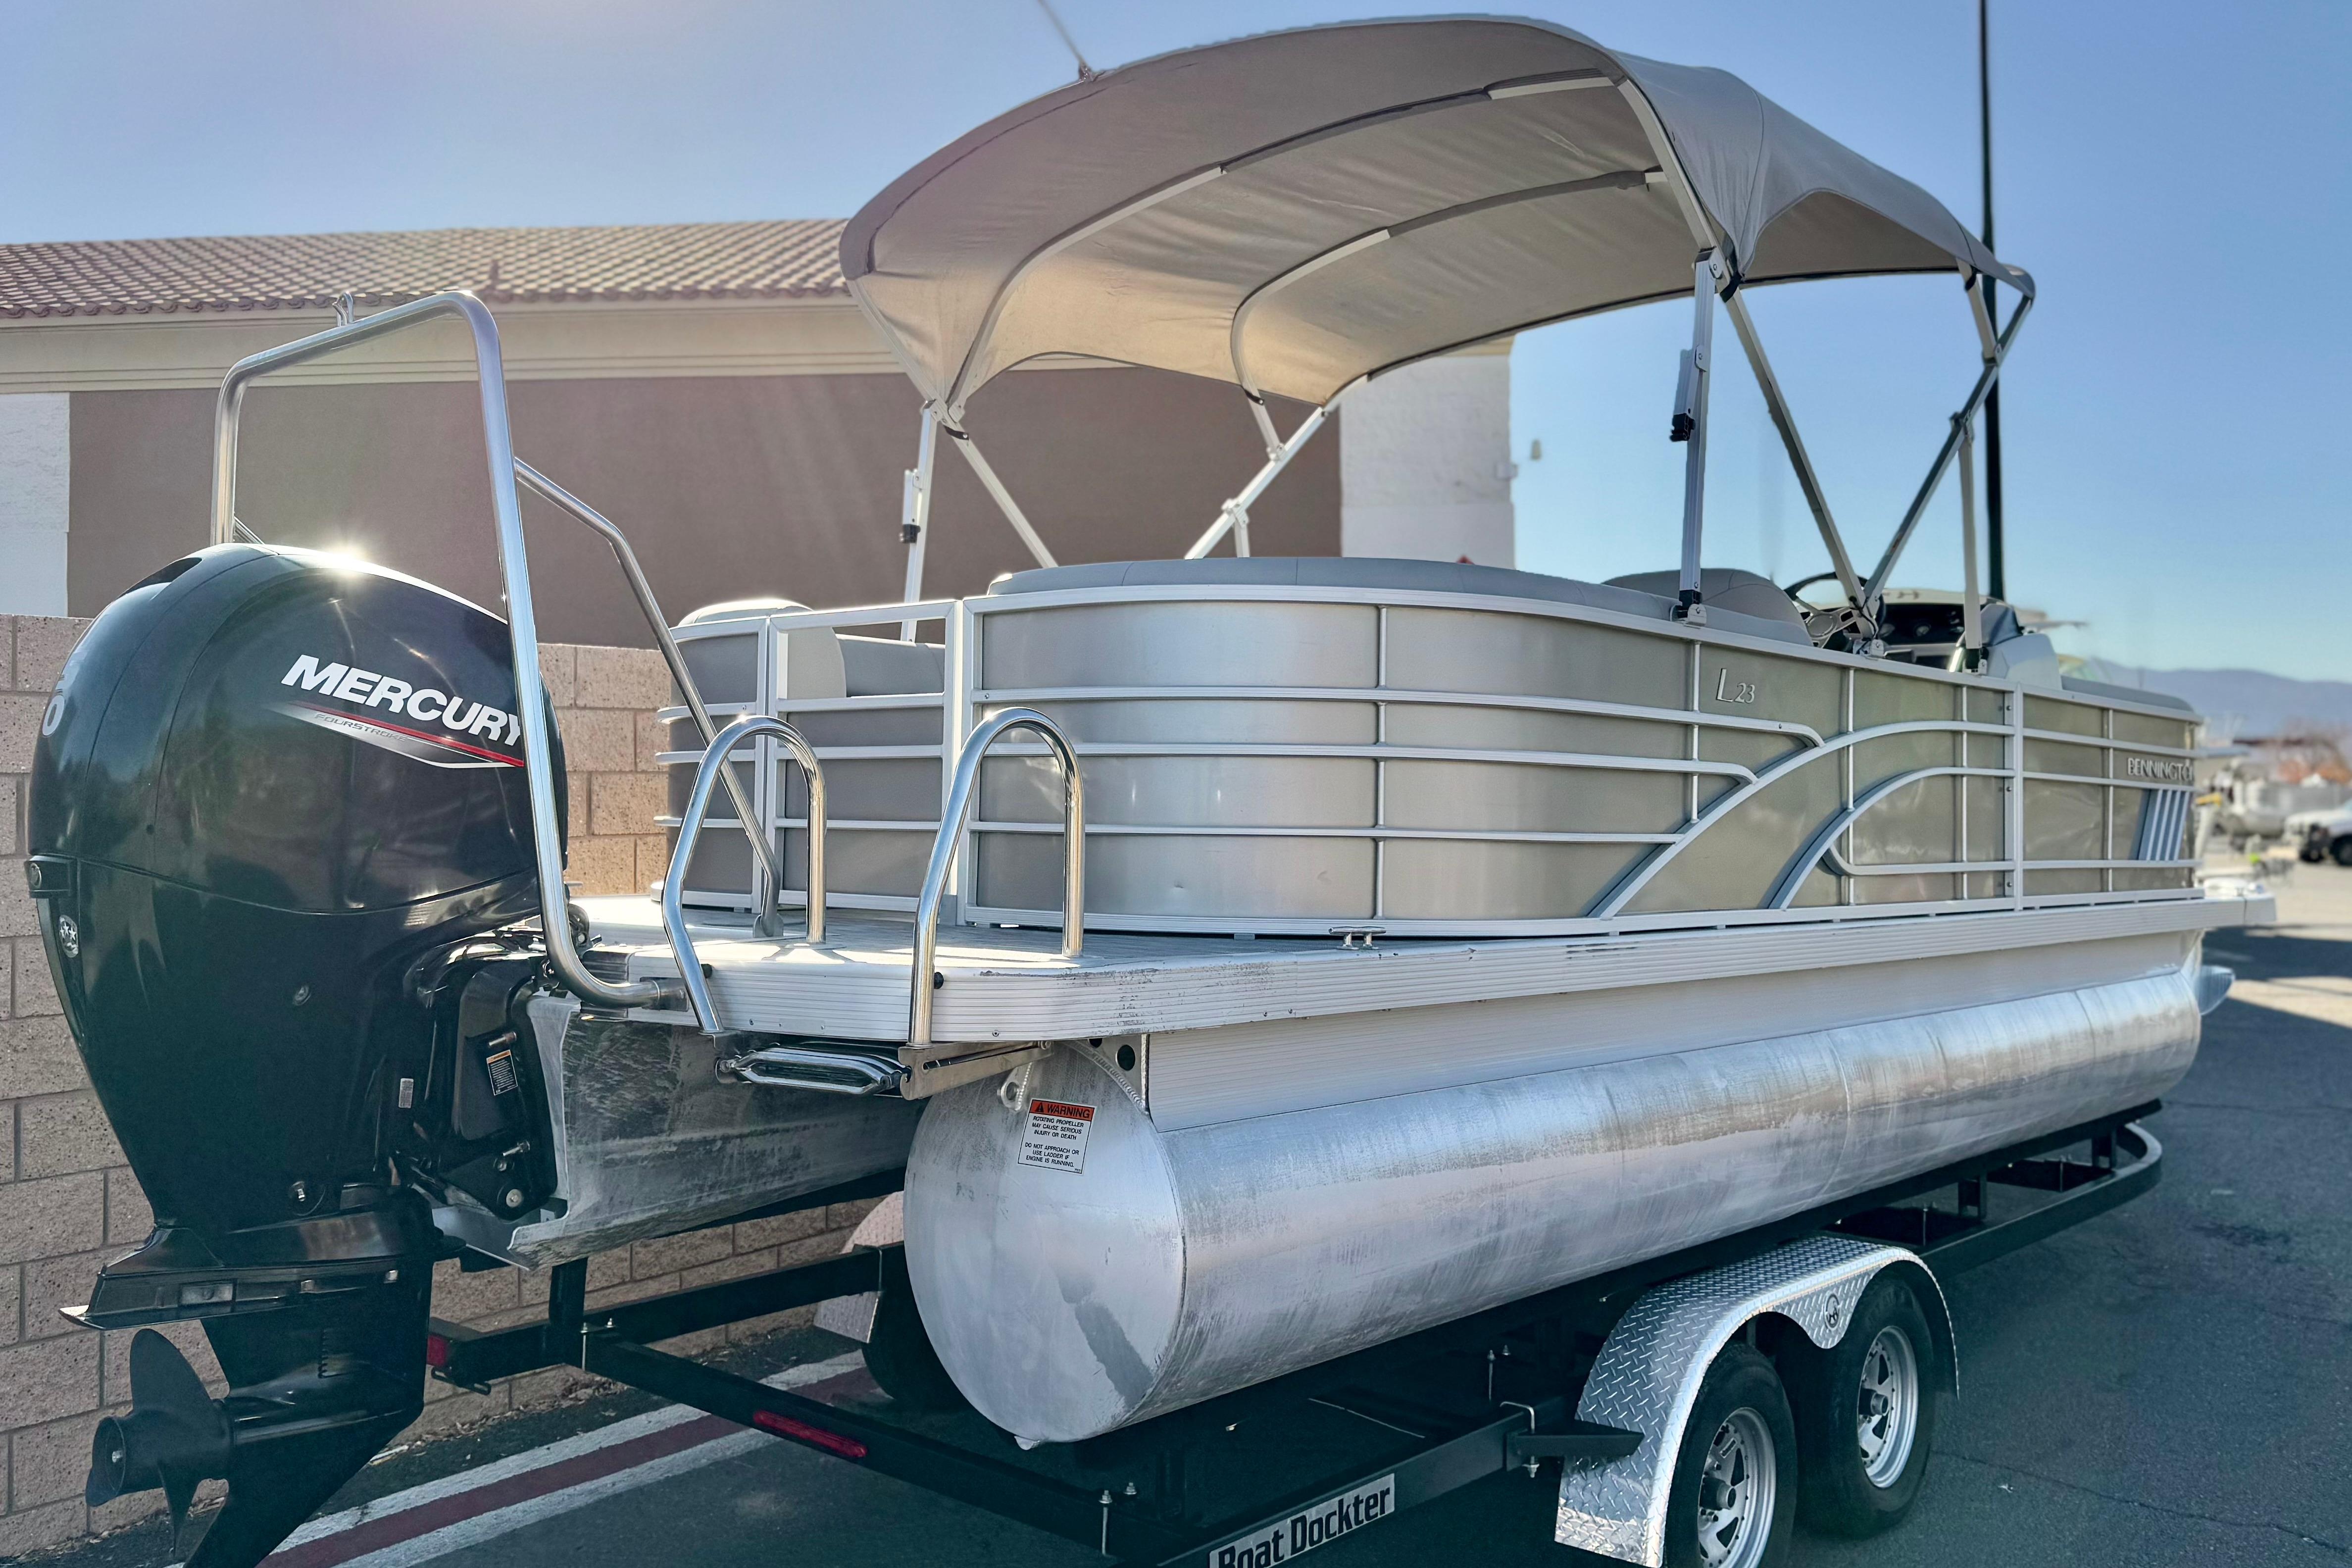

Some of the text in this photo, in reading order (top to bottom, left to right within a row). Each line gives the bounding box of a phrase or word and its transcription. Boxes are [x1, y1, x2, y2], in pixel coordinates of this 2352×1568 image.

[281, 654, 521, 746] MERCURY
[314, 713, 408, 742] FOURSTROKE
[1047, 1104, 1090, 1118] WARNING
[1056, 1119, 1084, 1127] PROPELLER
[1044, 1145, 1070, 1154] APPROACH
[1291, 1486, 1390, 1556] Dockter
